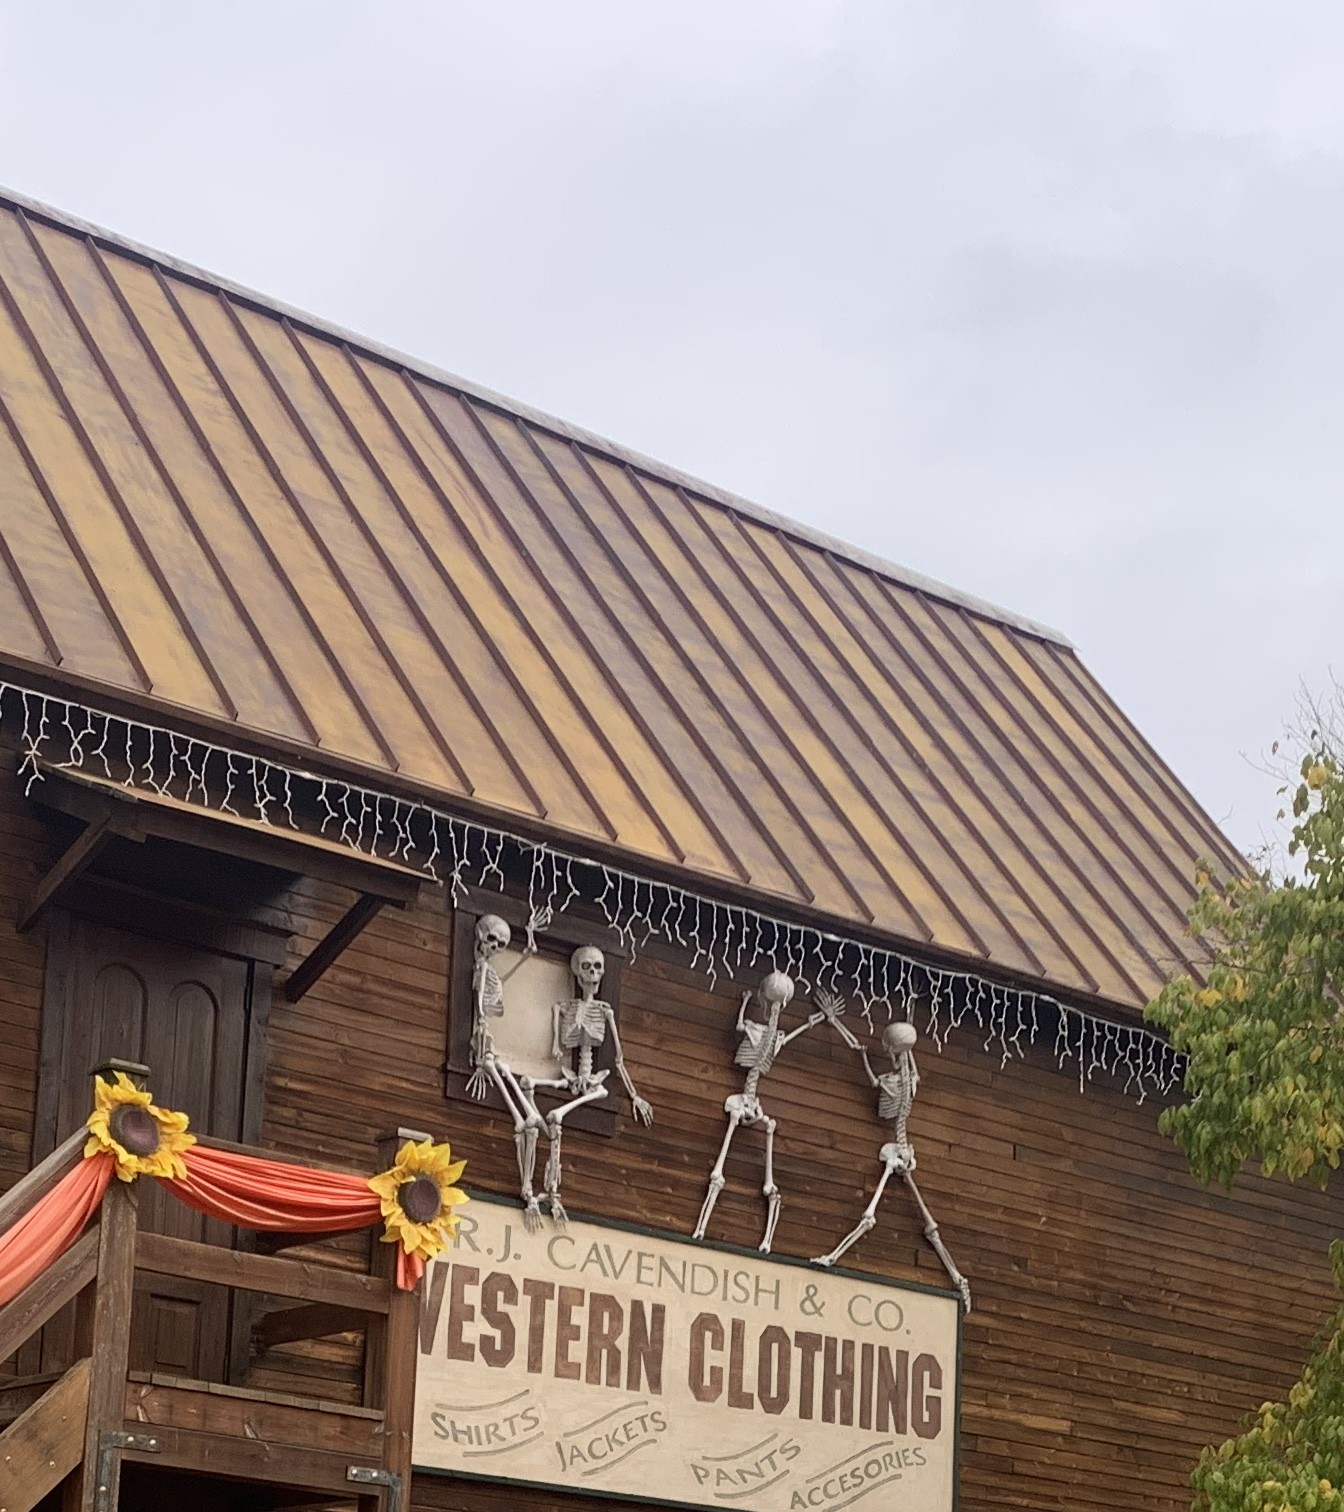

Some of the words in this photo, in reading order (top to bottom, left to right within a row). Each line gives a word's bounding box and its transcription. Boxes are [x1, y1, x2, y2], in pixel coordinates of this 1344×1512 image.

[547, 1235, 780, 1310] CAVENDISH
[799, 1284, 826, 1318] &
[847, 1294, 912, 1335] CO.
[688, 1312, 943, 1440] CLOTHING
[430, 1406, 540, 1447] SHIRTS
[556, 1410, 668, 1472] JACKETS
[690, 1438, 802, 1487] PANTS
[790, 1447, 927, 1510] ACCESORIES
